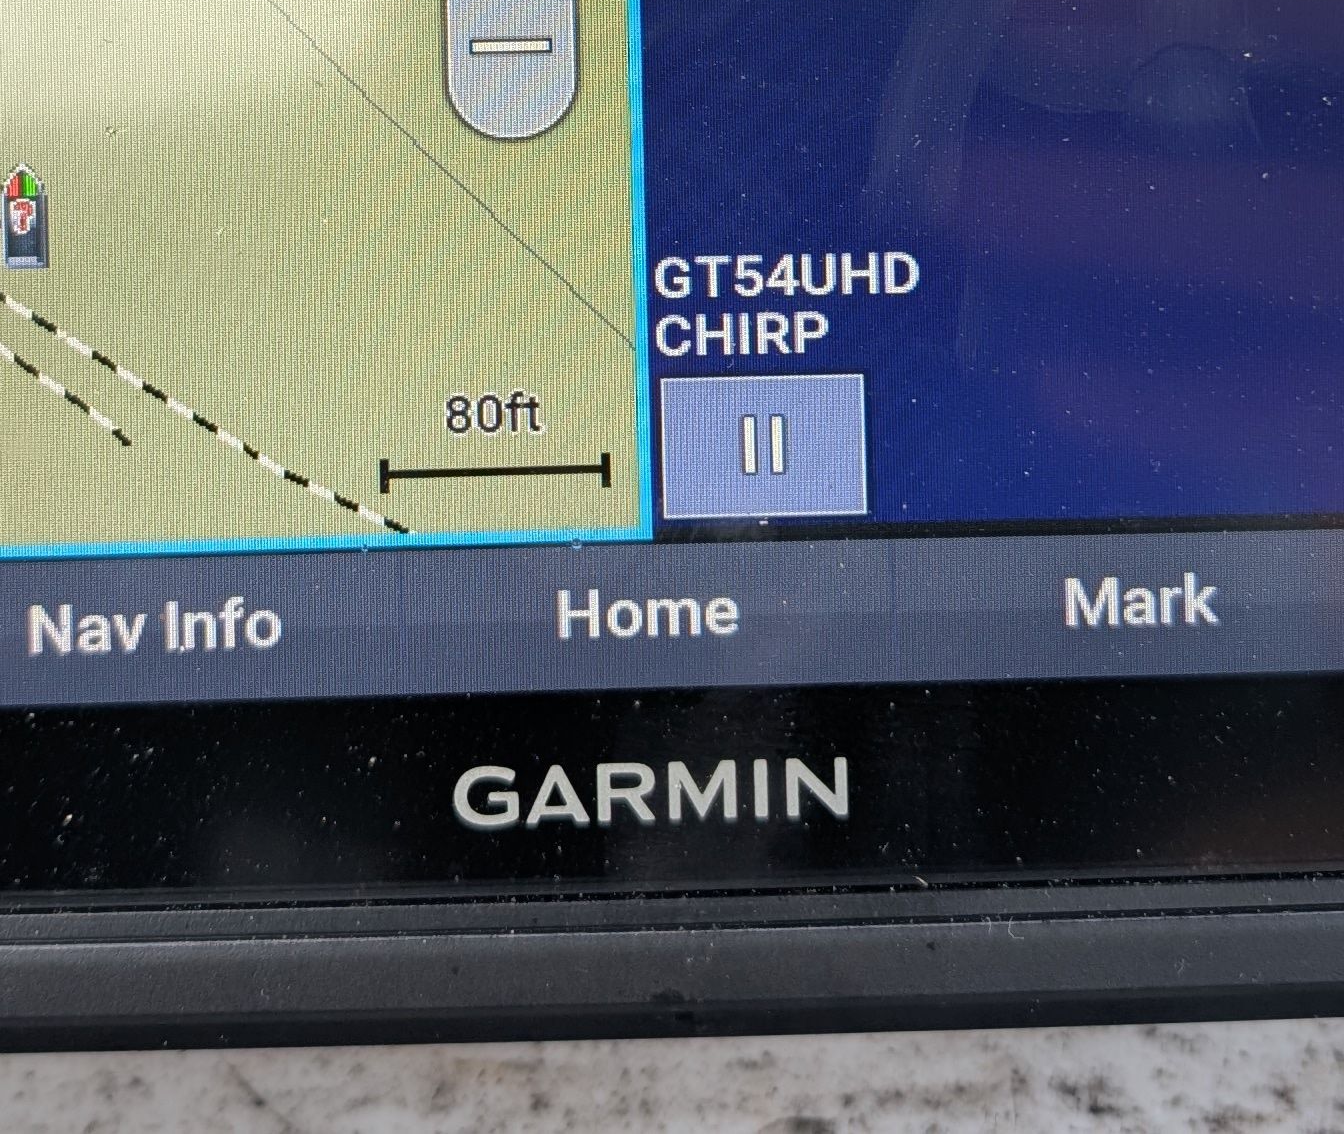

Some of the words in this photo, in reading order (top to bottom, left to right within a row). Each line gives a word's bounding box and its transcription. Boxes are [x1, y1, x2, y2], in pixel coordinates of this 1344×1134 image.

[655, 251, 921, 300] GT54UHD
[655, 311, 830, 357] CHIRP
[444, 391, 544, 436] 80ft
[27, 601, 149, 657] Nav
[164, 594, 284, 652] Info
[556, 588, 740, 640] Home
[1064, 571, 1220, 629] Mark
[453, 756, 850, 830] GARMIN
